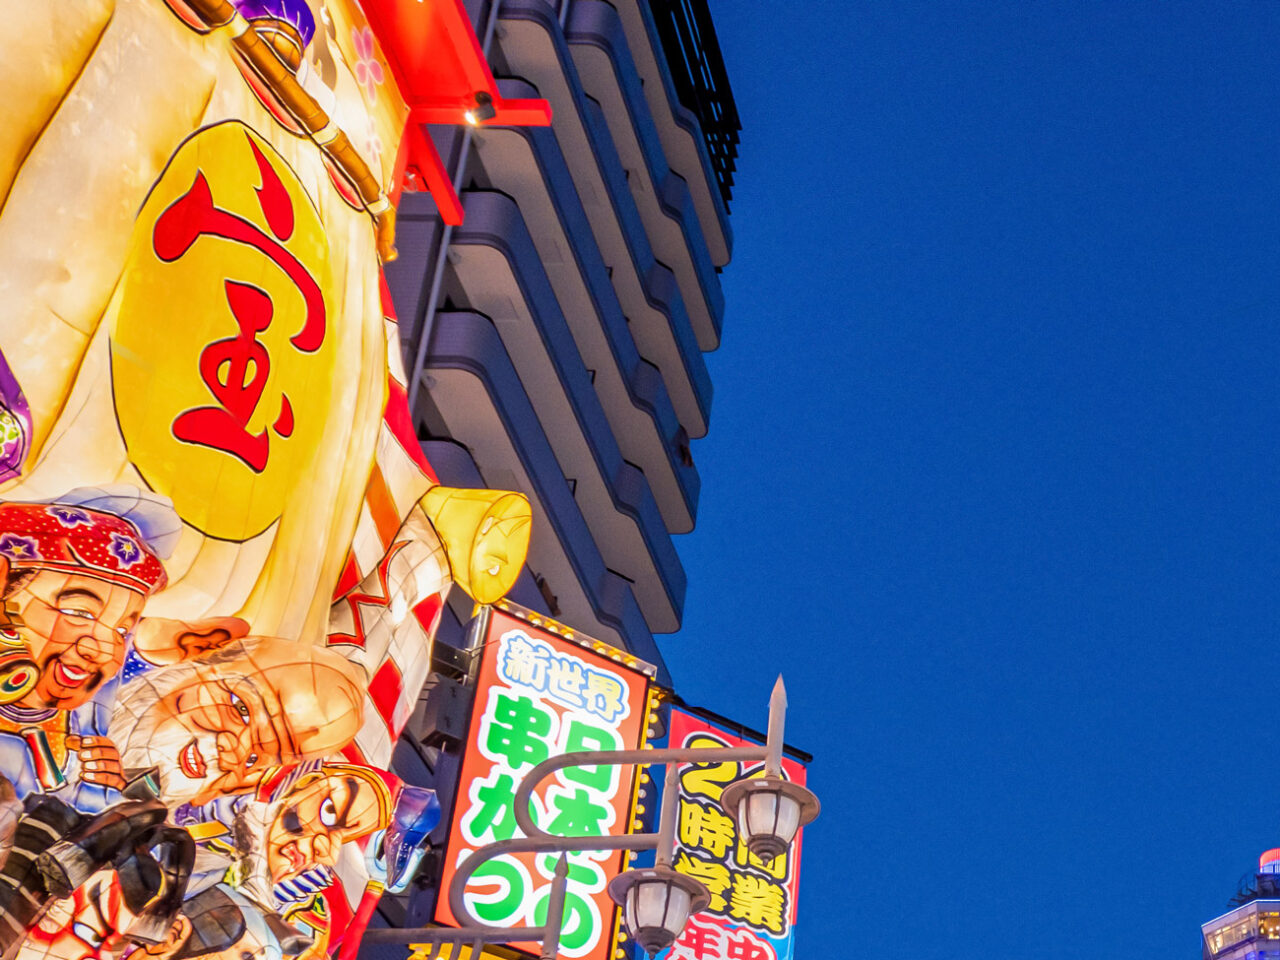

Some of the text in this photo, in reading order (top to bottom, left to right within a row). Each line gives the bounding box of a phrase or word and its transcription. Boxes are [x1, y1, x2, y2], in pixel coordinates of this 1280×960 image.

[153, 128, 327, 473] 宝
[505, 635, 625, 720] 新世界
[466, 694, 551, 921] 串かつ
[534, 721, 616, 949] 日本一の
